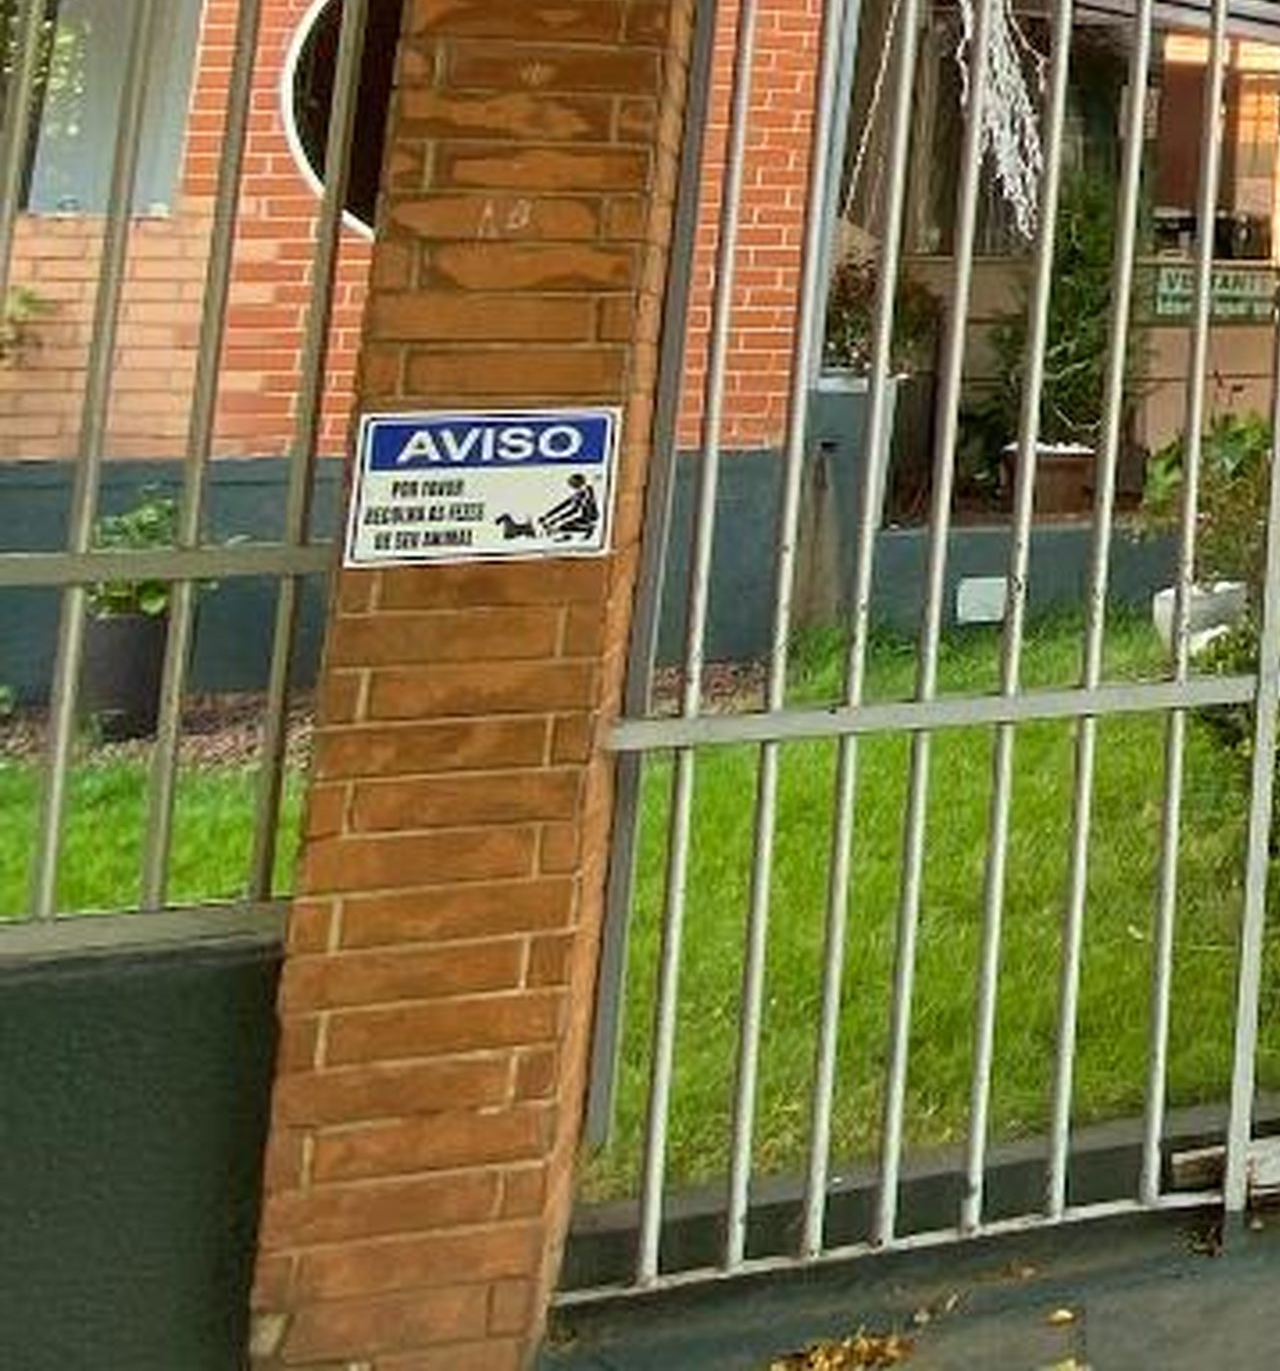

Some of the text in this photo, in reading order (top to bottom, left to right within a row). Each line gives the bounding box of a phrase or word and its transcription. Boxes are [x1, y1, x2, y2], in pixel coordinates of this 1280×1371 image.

[396, 425, 584, 464] AVISO
[391, 479, 464, 499] POR FAVOR
[363, 506, 425, 525] RECOLHA
